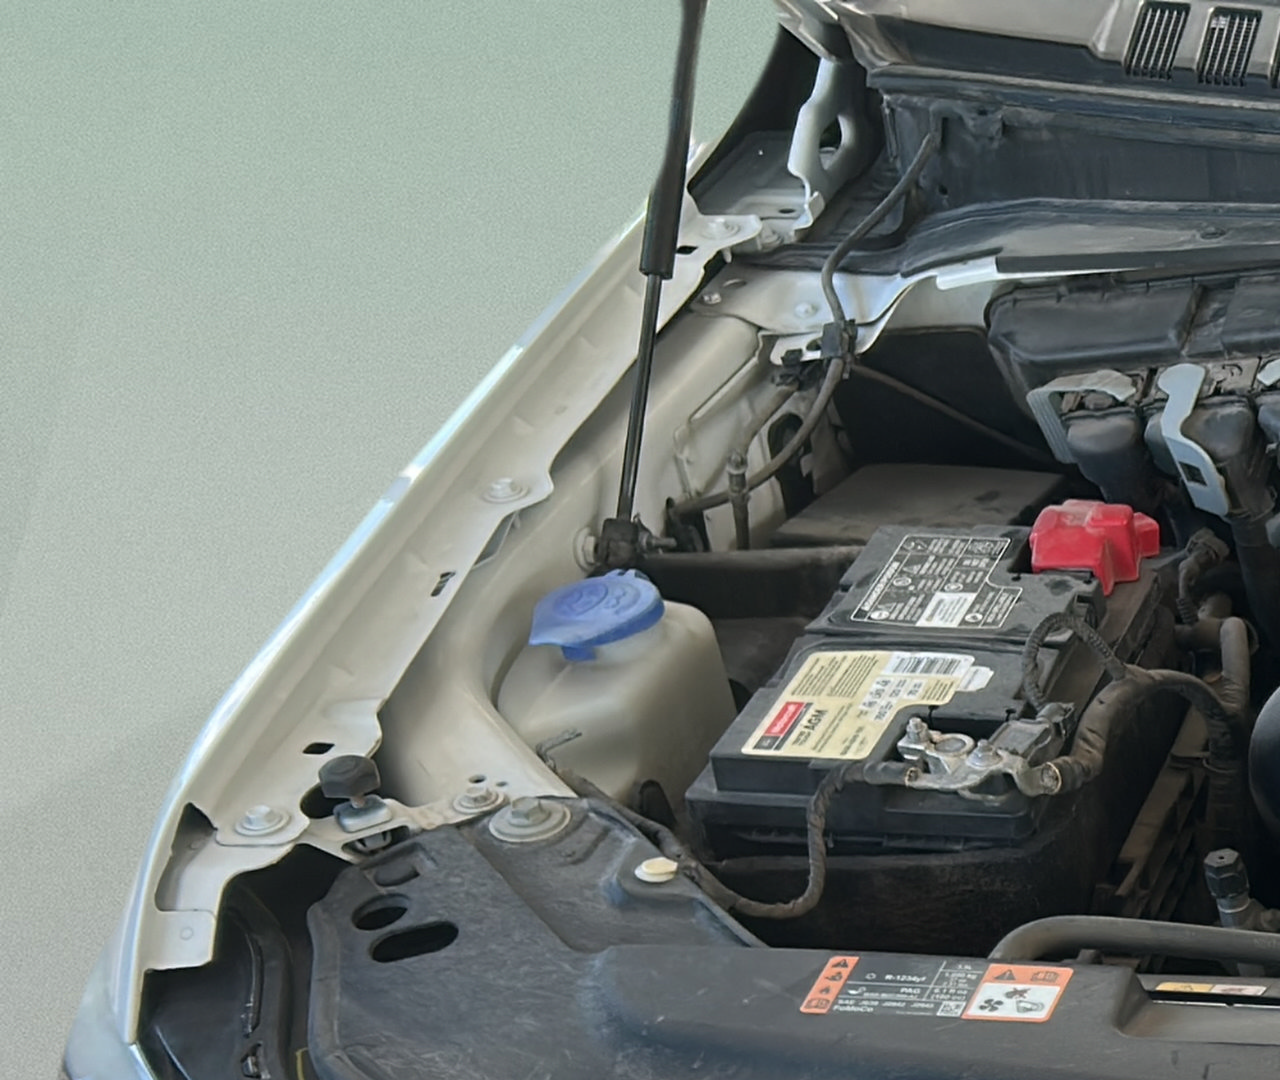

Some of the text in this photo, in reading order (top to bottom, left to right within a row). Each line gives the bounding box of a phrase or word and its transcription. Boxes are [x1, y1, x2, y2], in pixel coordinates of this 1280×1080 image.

[803, 709, 828, 731] AGM
[884, 973, 927, 983] R-1234yf
[900, 987, 921, 995] PAG
